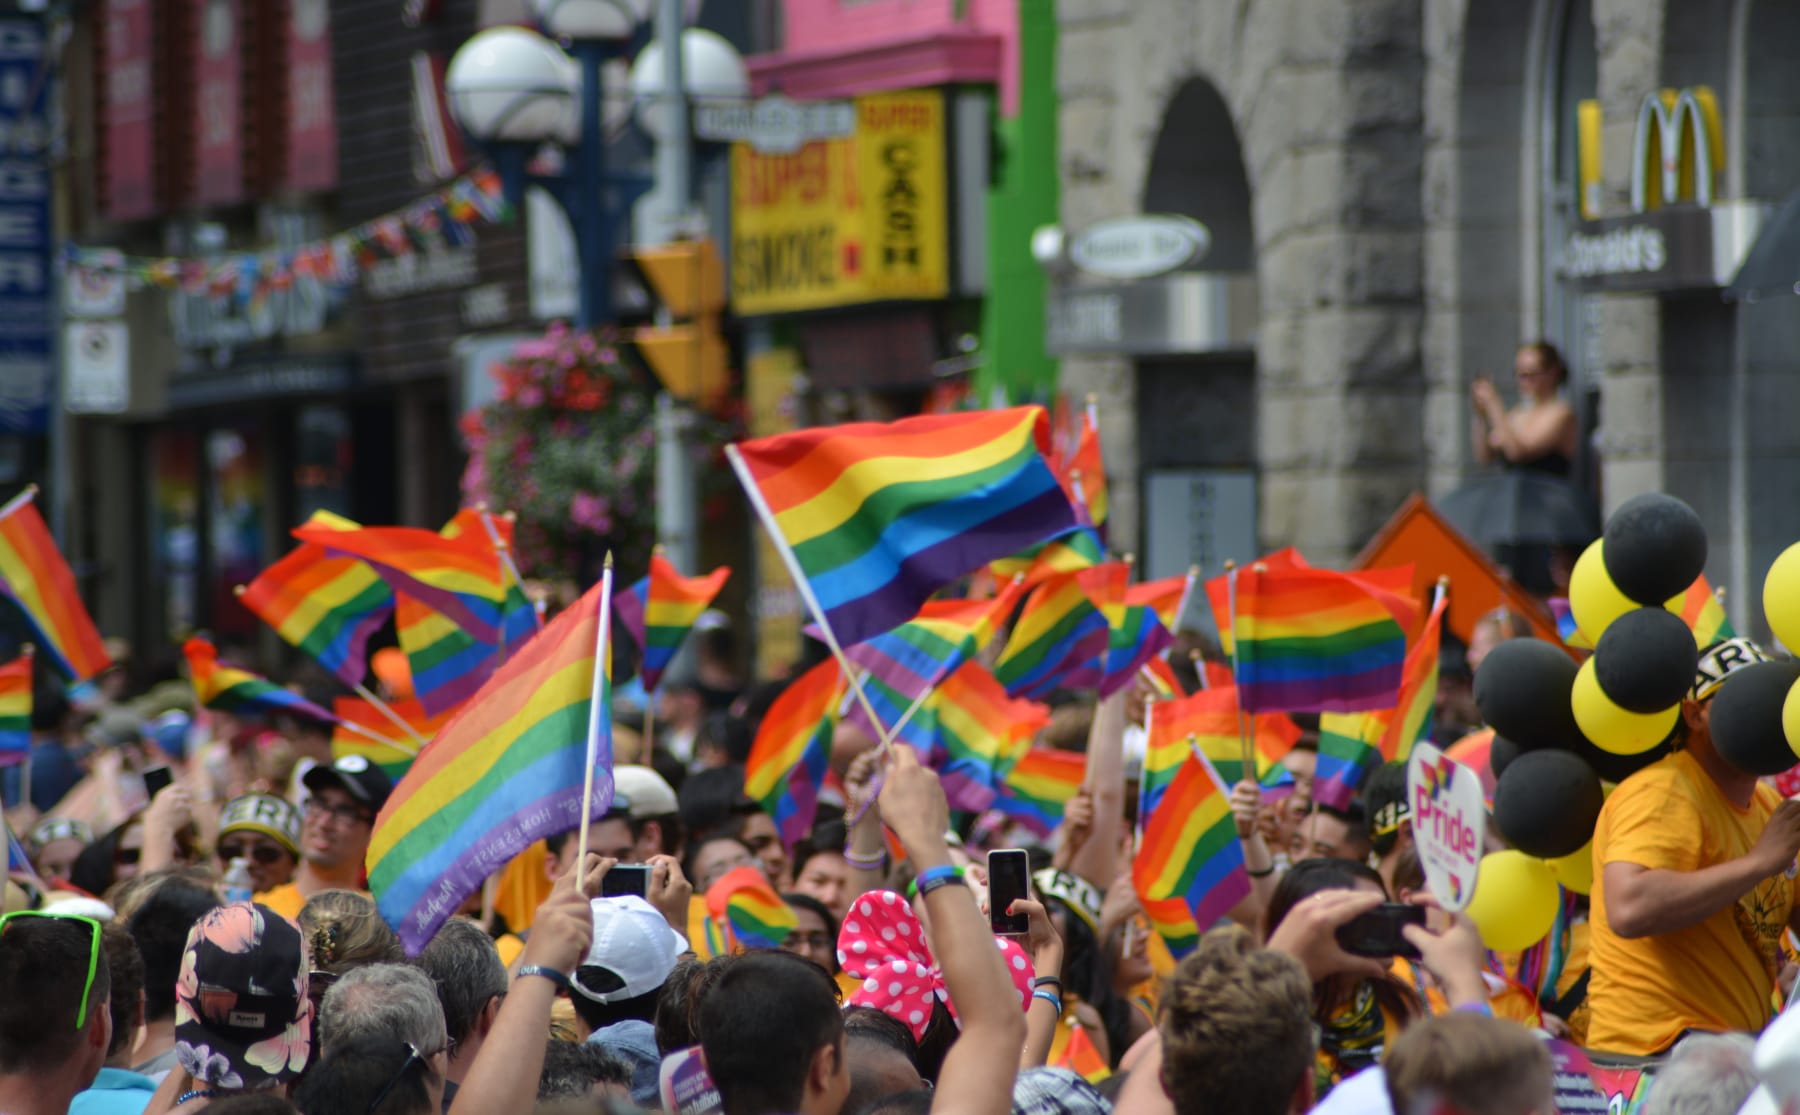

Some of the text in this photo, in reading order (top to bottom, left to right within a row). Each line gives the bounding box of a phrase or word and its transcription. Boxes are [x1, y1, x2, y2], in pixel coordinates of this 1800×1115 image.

[882, 144, 920, 269] CASH
[732, 223, 836, 295] SMOKE
[1415, 784, 1477, 865] Pride
